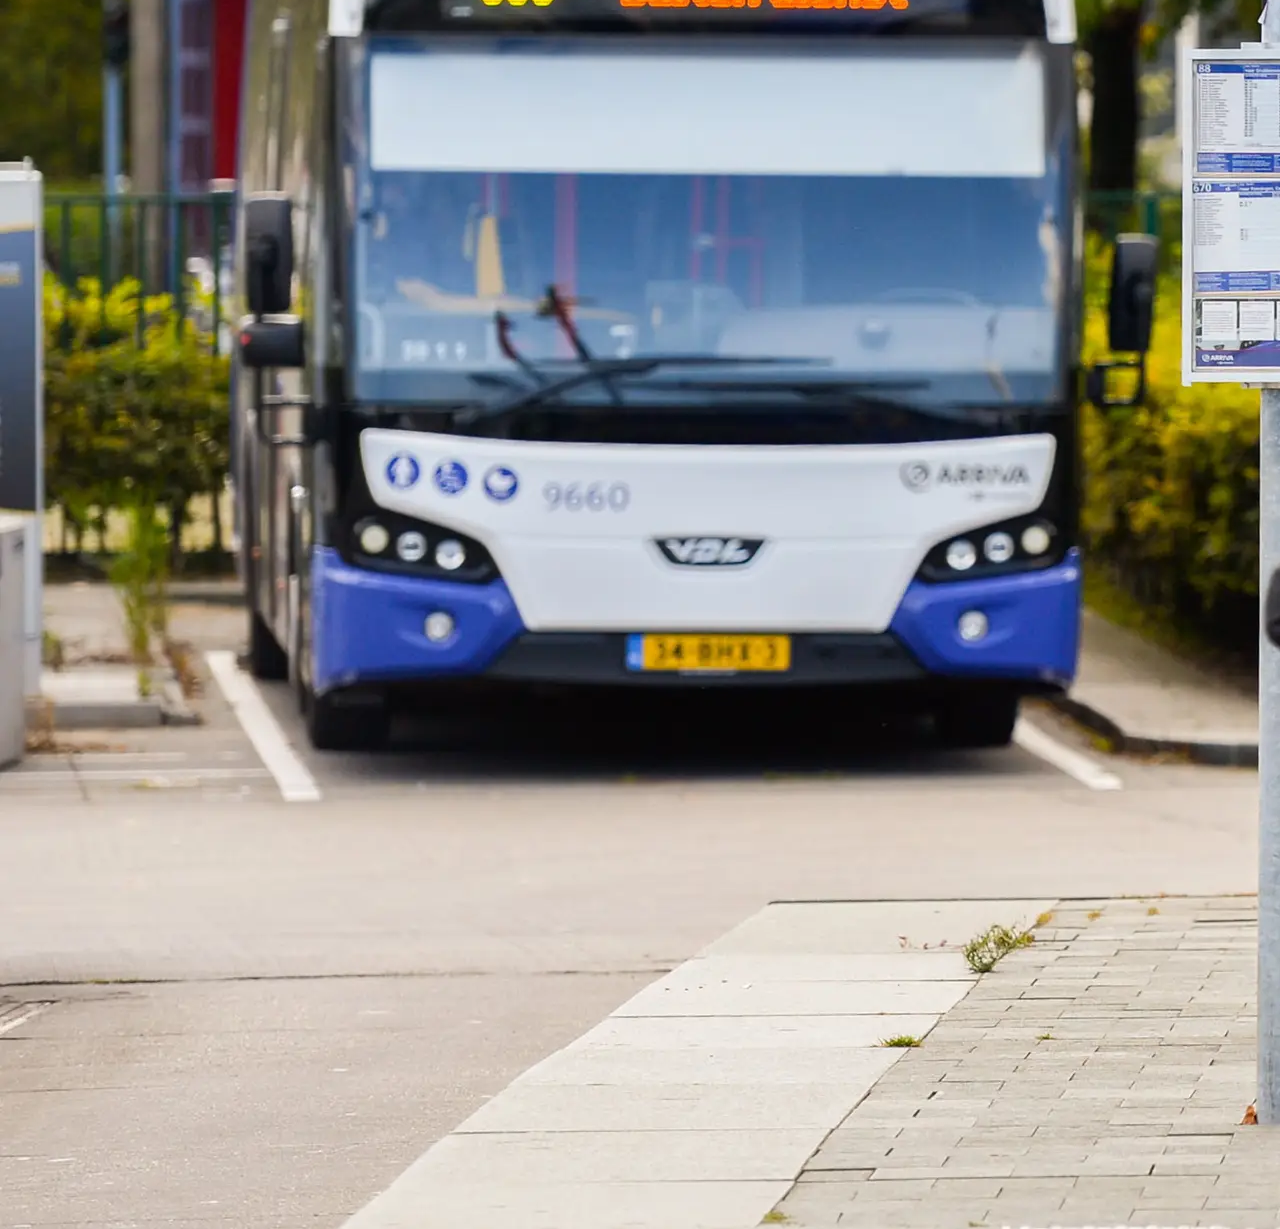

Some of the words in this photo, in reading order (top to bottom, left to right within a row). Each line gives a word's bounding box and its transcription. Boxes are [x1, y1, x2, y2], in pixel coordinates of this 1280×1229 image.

[1198, 63, 1211, 73] 88
[1193, 182, 1212, 193] 670
[543, 481, 631, 512] 9660
